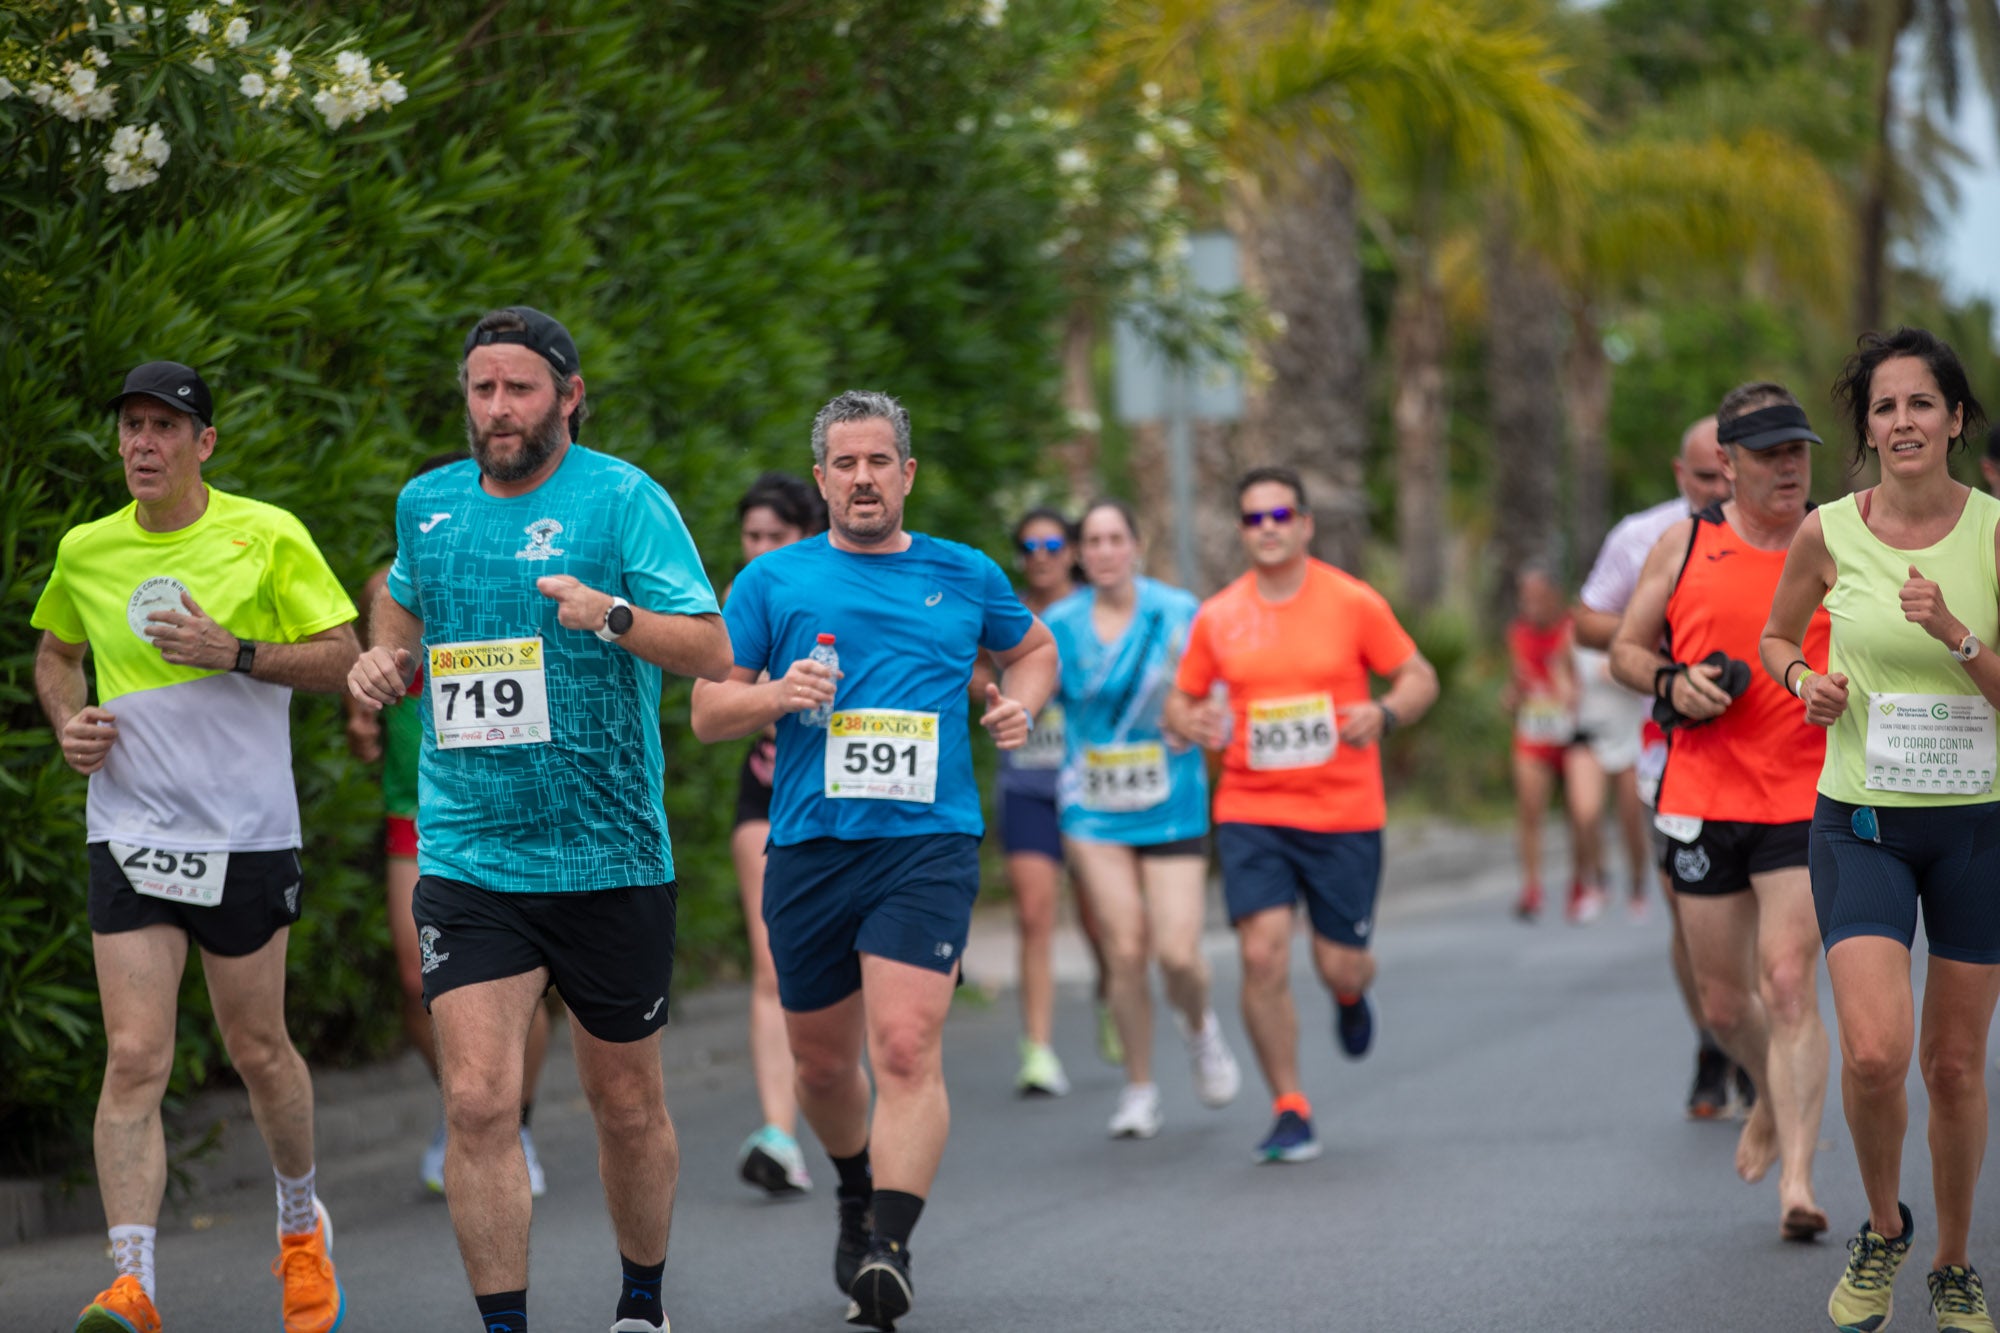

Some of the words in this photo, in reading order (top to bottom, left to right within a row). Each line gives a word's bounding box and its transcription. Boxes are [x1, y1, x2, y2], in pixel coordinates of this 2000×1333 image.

[439, 651, 452, 670] 38
[452, 653, 514, 669] FONDO
[455, 648, 475, 656] GRAN
[476, 646, 508, 654] PREMIO
[441, 679, 524, 721] 719
[1896, 706, 1927, 714] Diputación
[844, 715, 862, 731] 38
[862, 720, 918, 734] FONDO
[1253, 722, 1330, 752] 3036
[1888, 736, 1901, 749] YO
[1903, 736, 1937, 749] CORRO
[1939, 737, 1974, 750] CONTRA
[844, 743, 917, 777] 591
[1905, 751, 1917, 764] EL
[1919, 751, 1958, 765] CÁNCER
[123, 843, 208, 880] 255
